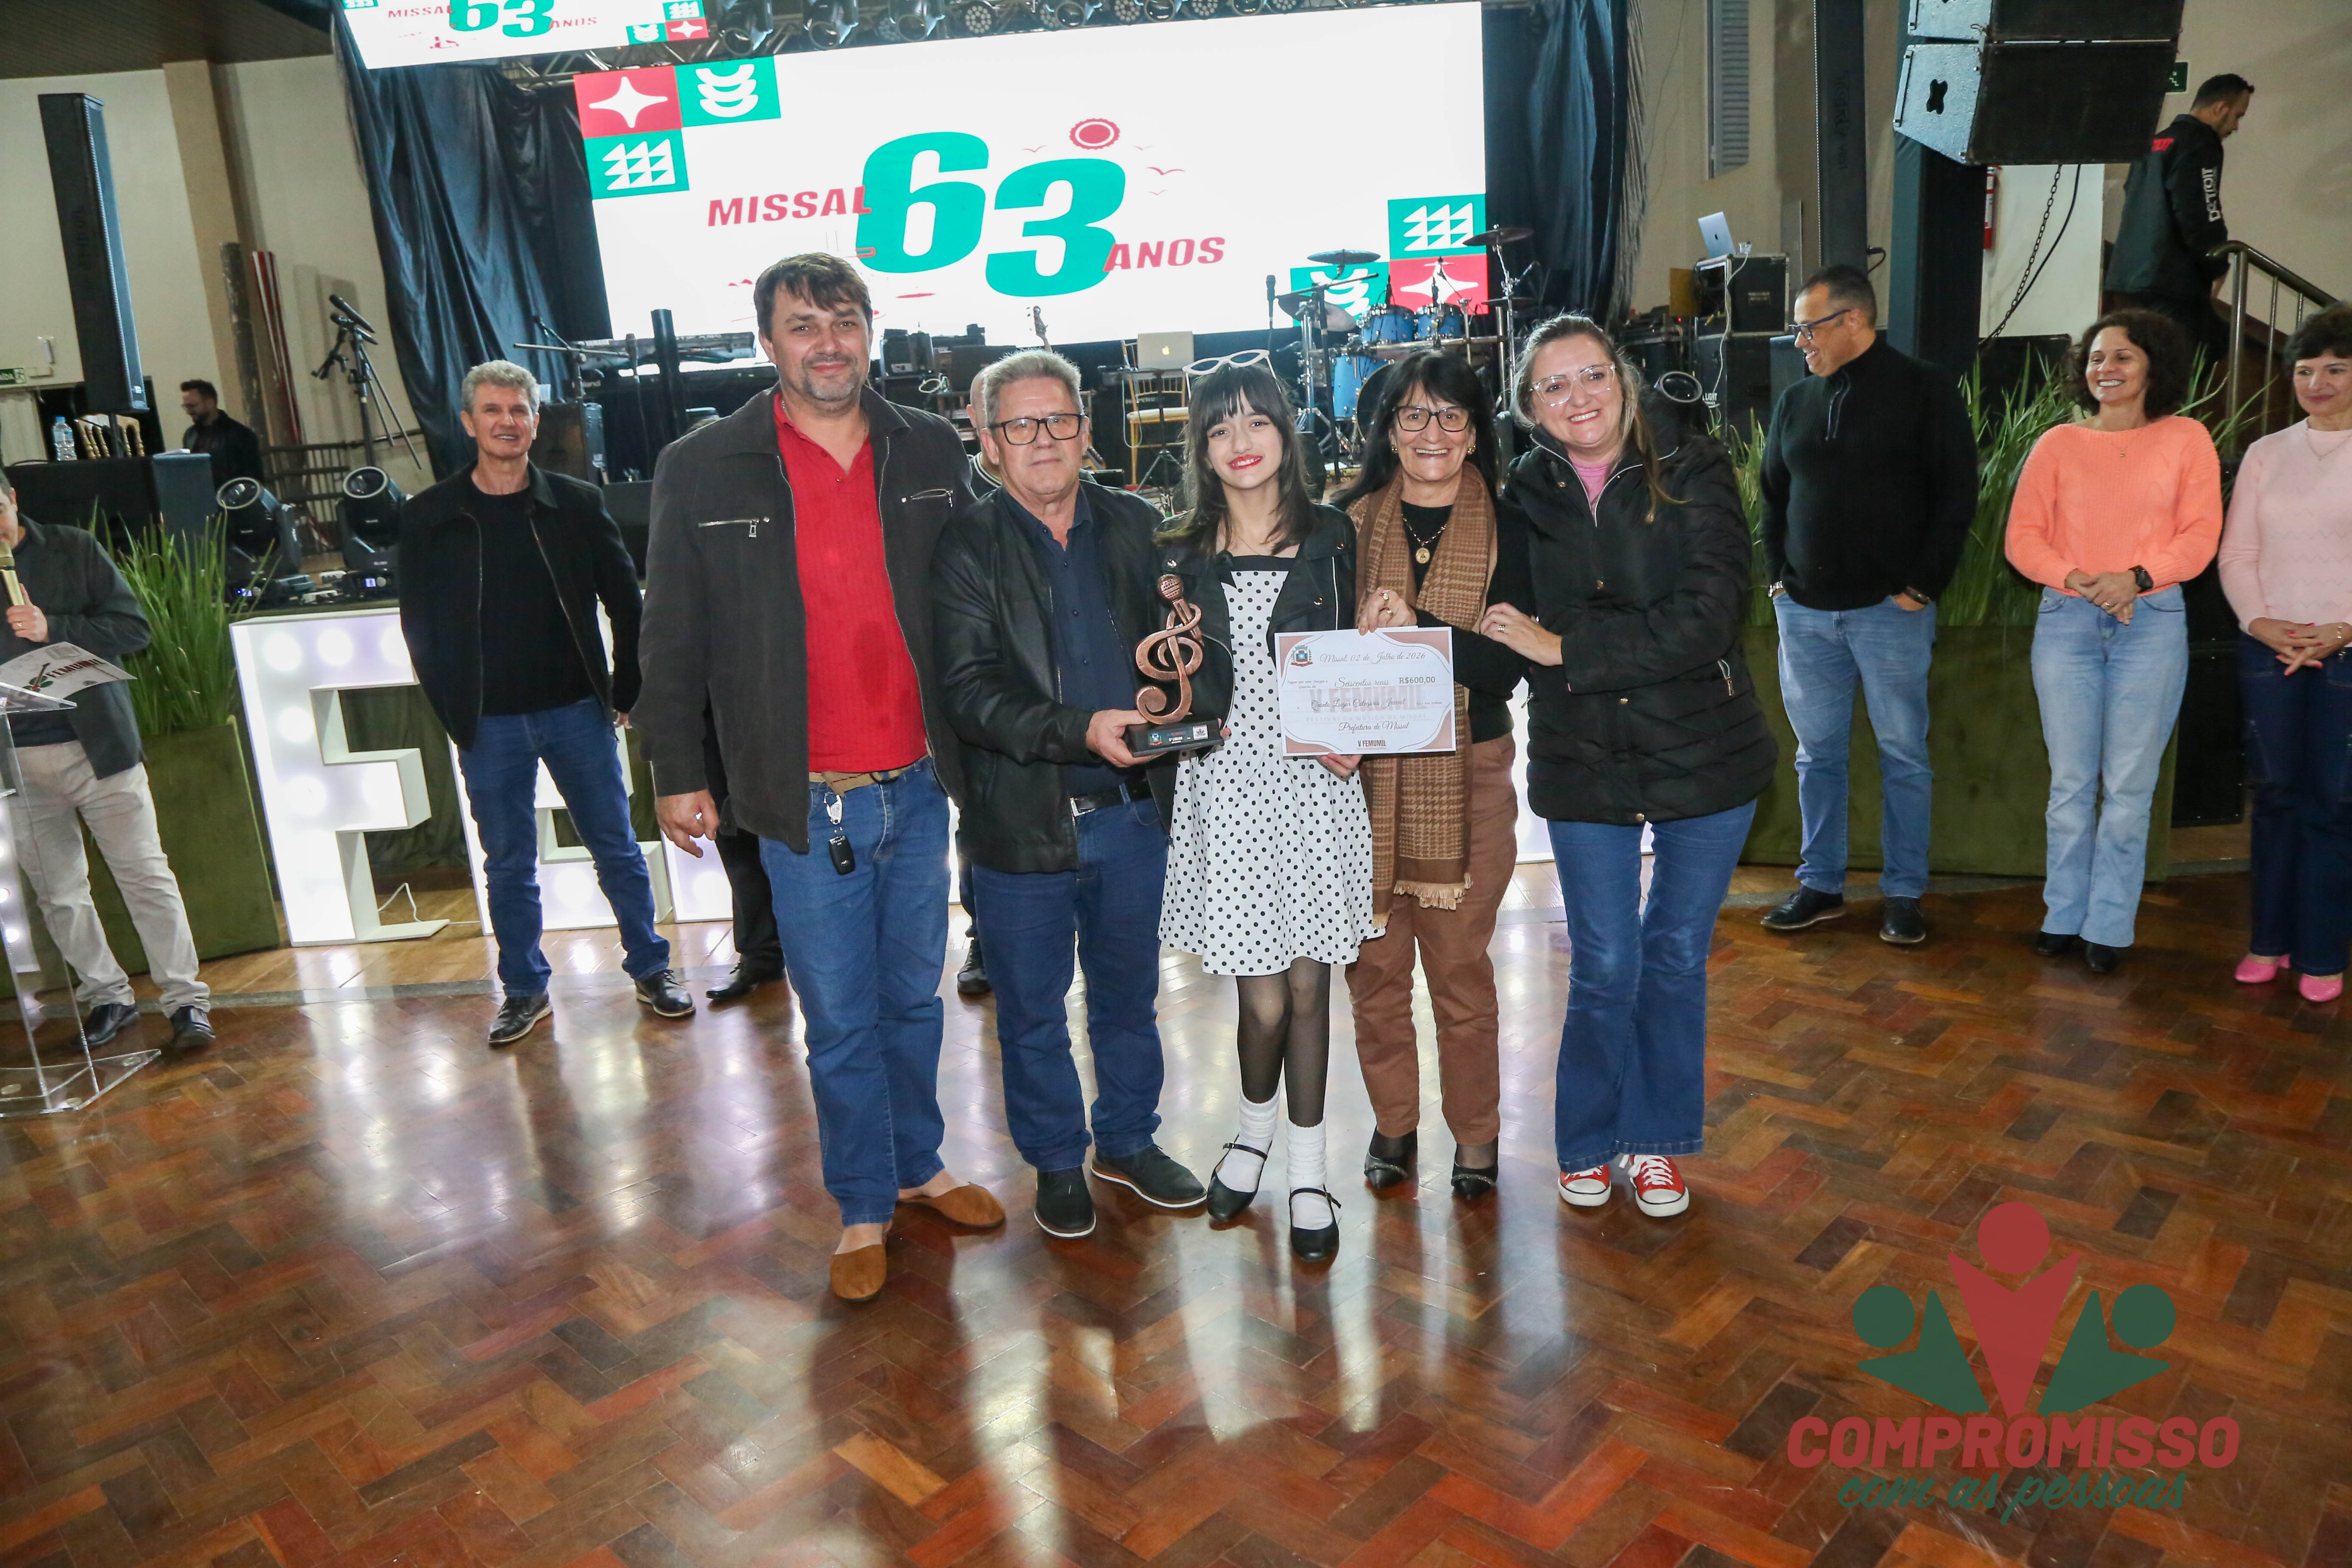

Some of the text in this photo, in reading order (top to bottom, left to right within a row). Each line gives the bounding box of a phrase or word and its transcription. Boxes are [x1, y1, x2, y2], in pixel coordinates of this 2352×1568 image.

[388, 5, 453, 18] MISSAL
[449, 0, 554, 37] 63
[707, 132, 1225, 297] MISSAL 63 ANOS
[1371, 651, 1394, 664] Julho
[1334, 677, 1371, 688] Seiscentos
[1399, 676, 1436, 684] R$600,00
[1311, 698, 1406, 711] Quinto Lugar Categoria Juvenil
[1338, 722, 1371, 734] Prefeitura
[1382, 720, 1410, 730] Missal
